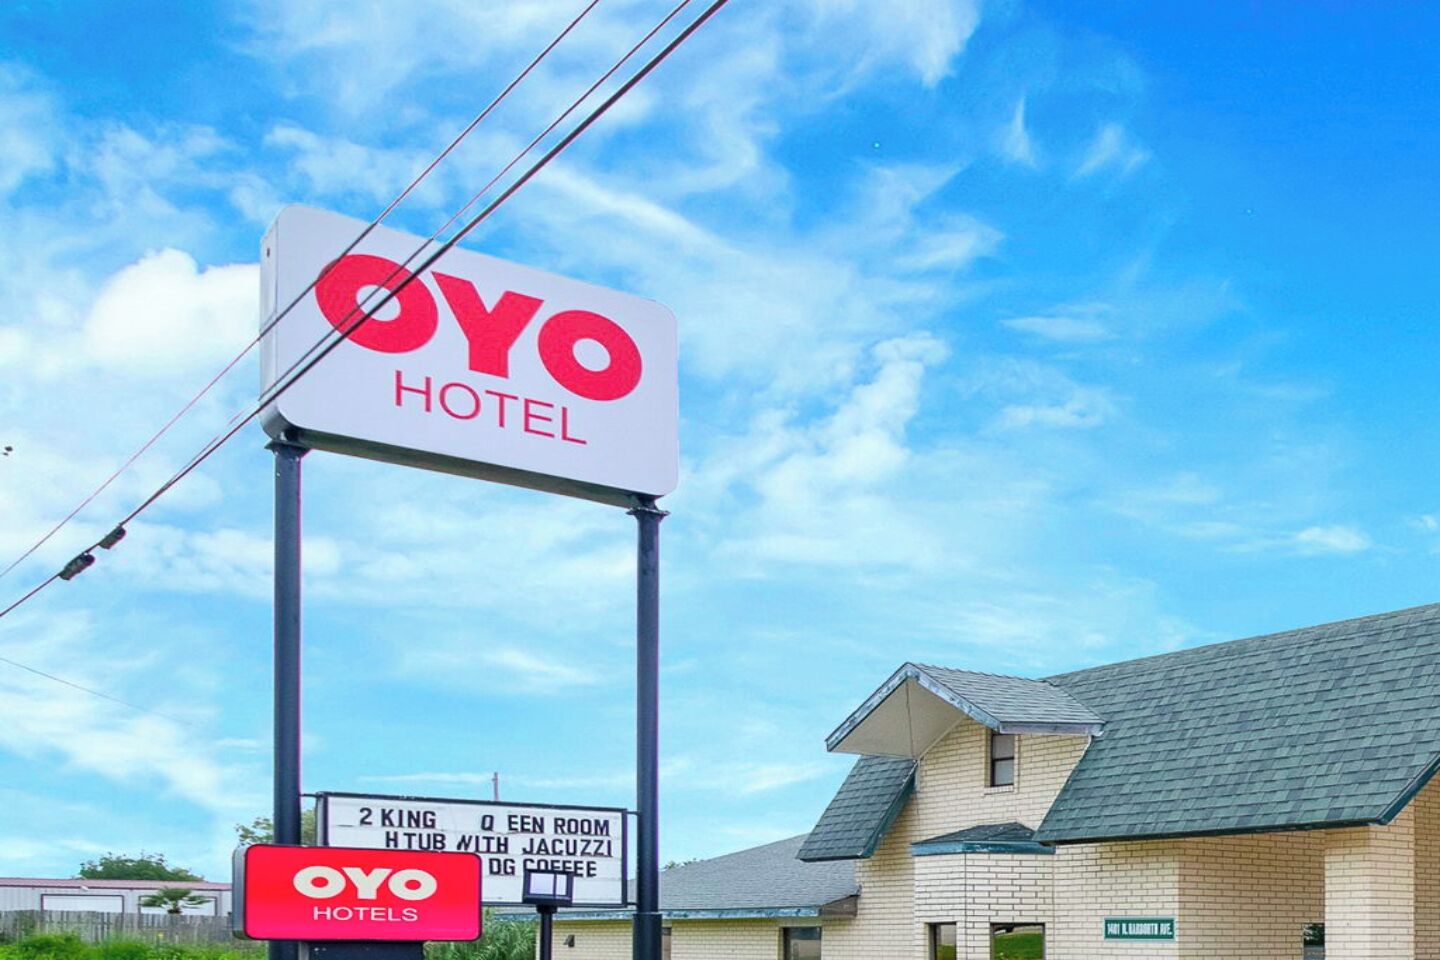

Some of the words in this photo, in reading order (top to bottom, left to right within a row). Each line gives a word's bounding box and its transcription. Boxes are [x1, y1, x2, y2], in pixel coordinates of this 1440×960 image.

[315, 254, 642, 402] OYO
[394, 369, 587, 445] HOTEL
[359, 807, 373, 826] 2
[381, 808, 437, 829] KING
[554, 817, 610, 836] ROOM
[403, 832, 446, 850] TUB
[522, 837, 613, 858] JACUZZI
[293, 865, 438, 901] OYO
[313, 905, 419, 922] HOTELS
